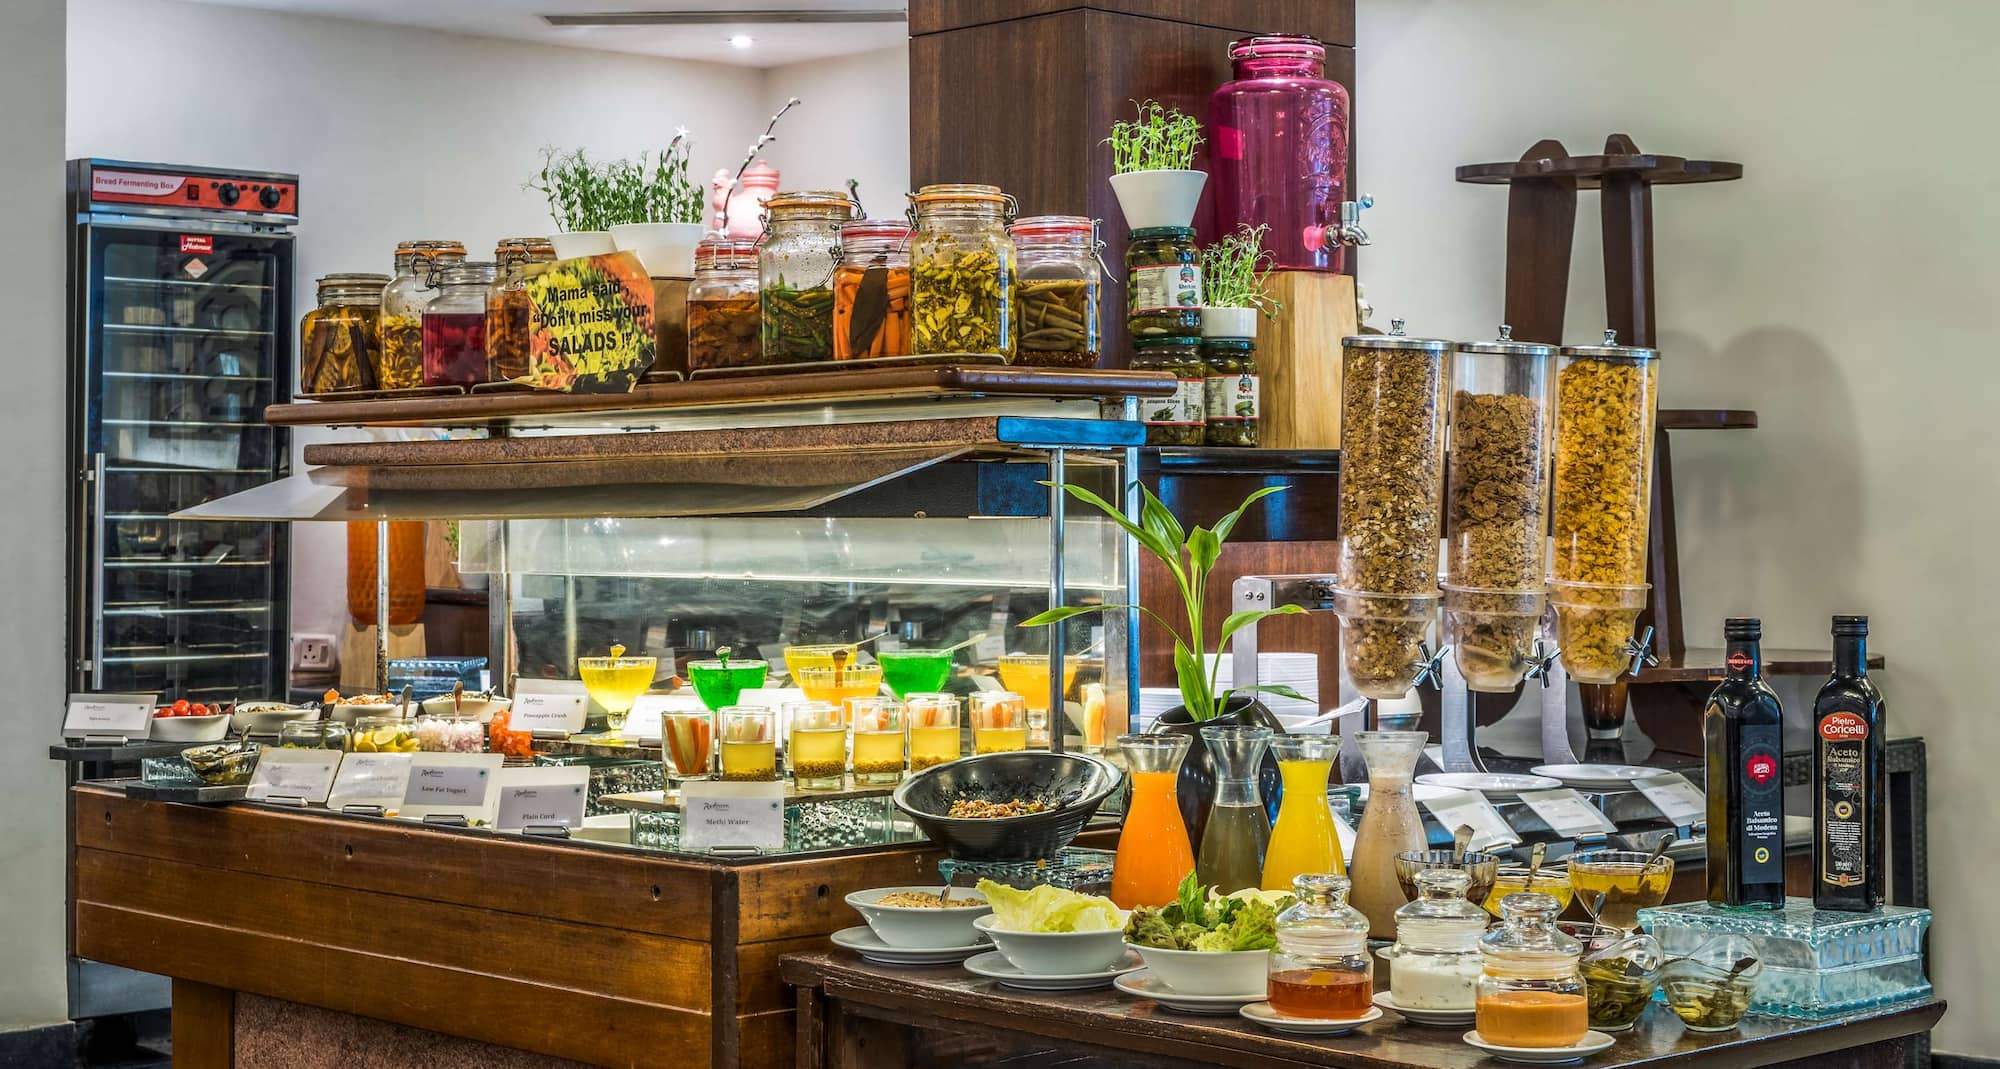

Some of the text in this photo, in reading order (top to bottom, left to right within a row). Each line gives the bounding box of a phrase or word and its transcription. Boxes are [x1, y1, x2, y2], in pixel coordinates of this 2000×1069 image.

[95, 176, 174, 190] Bread Fermenting Box
[546, 286, 588, 303] Mama
[579, 306, 613, 324] miss
[616, 303, 647, 326] your
[548, 330, 617, 357] SALADS
[1831, 716, 1856, 726] Pietro
[1823, 724, 1865, 735] Coricelli
[1829, 747, 1859, 757] Aceto
[1753, 824, 1778, 832] Modena
